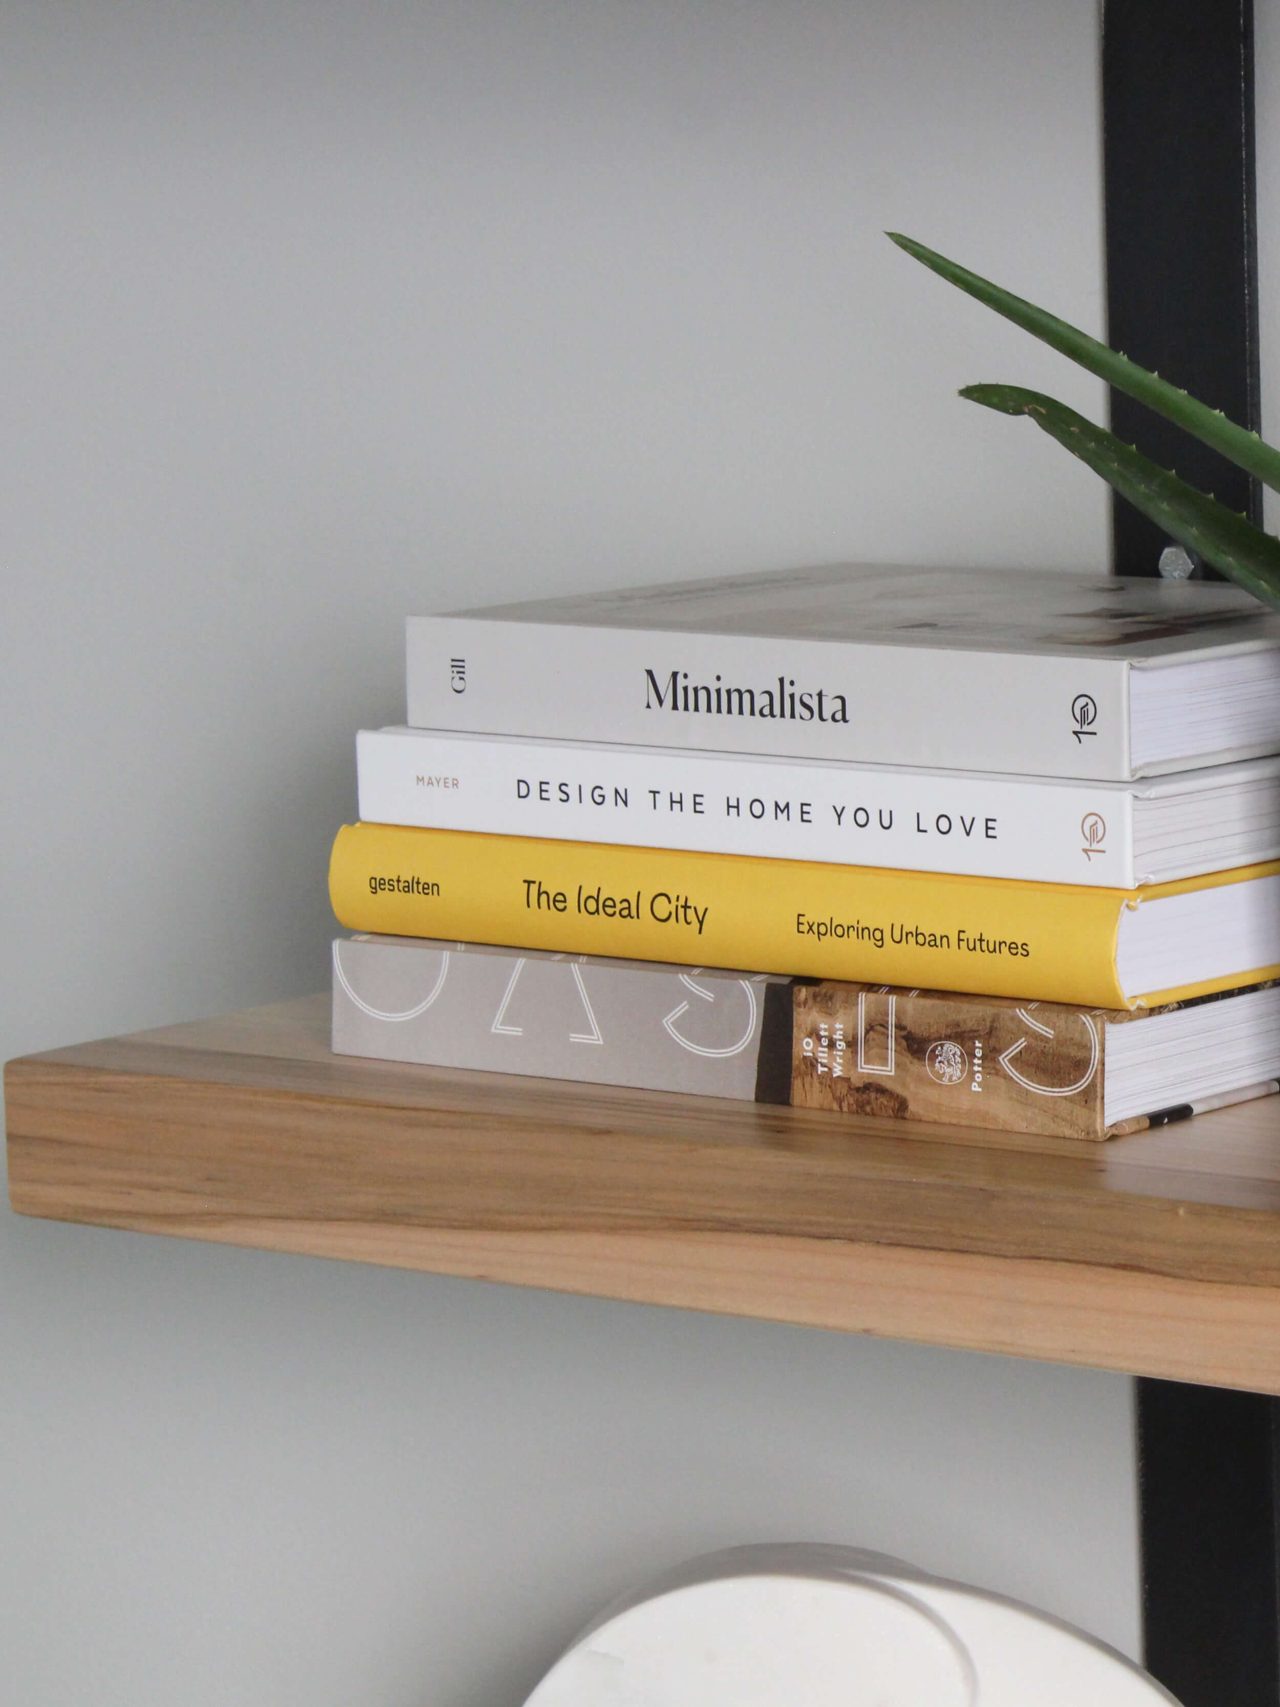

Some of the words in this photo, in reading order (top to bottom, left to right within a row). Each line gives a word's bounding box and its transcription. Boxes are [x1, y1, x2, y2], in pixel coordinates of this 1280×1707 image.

[450, 658, 467, 694] Gill
[643, 668, 850, 724] Minimalista
[415, 774, 460, 790] MAYER
[516, 778, 630, 808] DESIGN
[647, 789, 705, 815] THE
[726, 796, 814, 825] HOME
[831, 804, 894, 831] YOU
[915, 811, 999, 840] LOVE
[368, 875, 441, 897] gestalten
[522, 879, 568, 913] The
[576, 884, 642, 921] Ideal
[649, 892, 709, 935] City
[795, 913, 886, 950] Exploring
[889, 922, 952, 950] Urban
[956, 929, 1031, 959] Futures
[817, 1022, 829, 1075] Tillett
[832, 1021, 847, 1078] Wright
[970, 1039, 983, 1093] Potter
